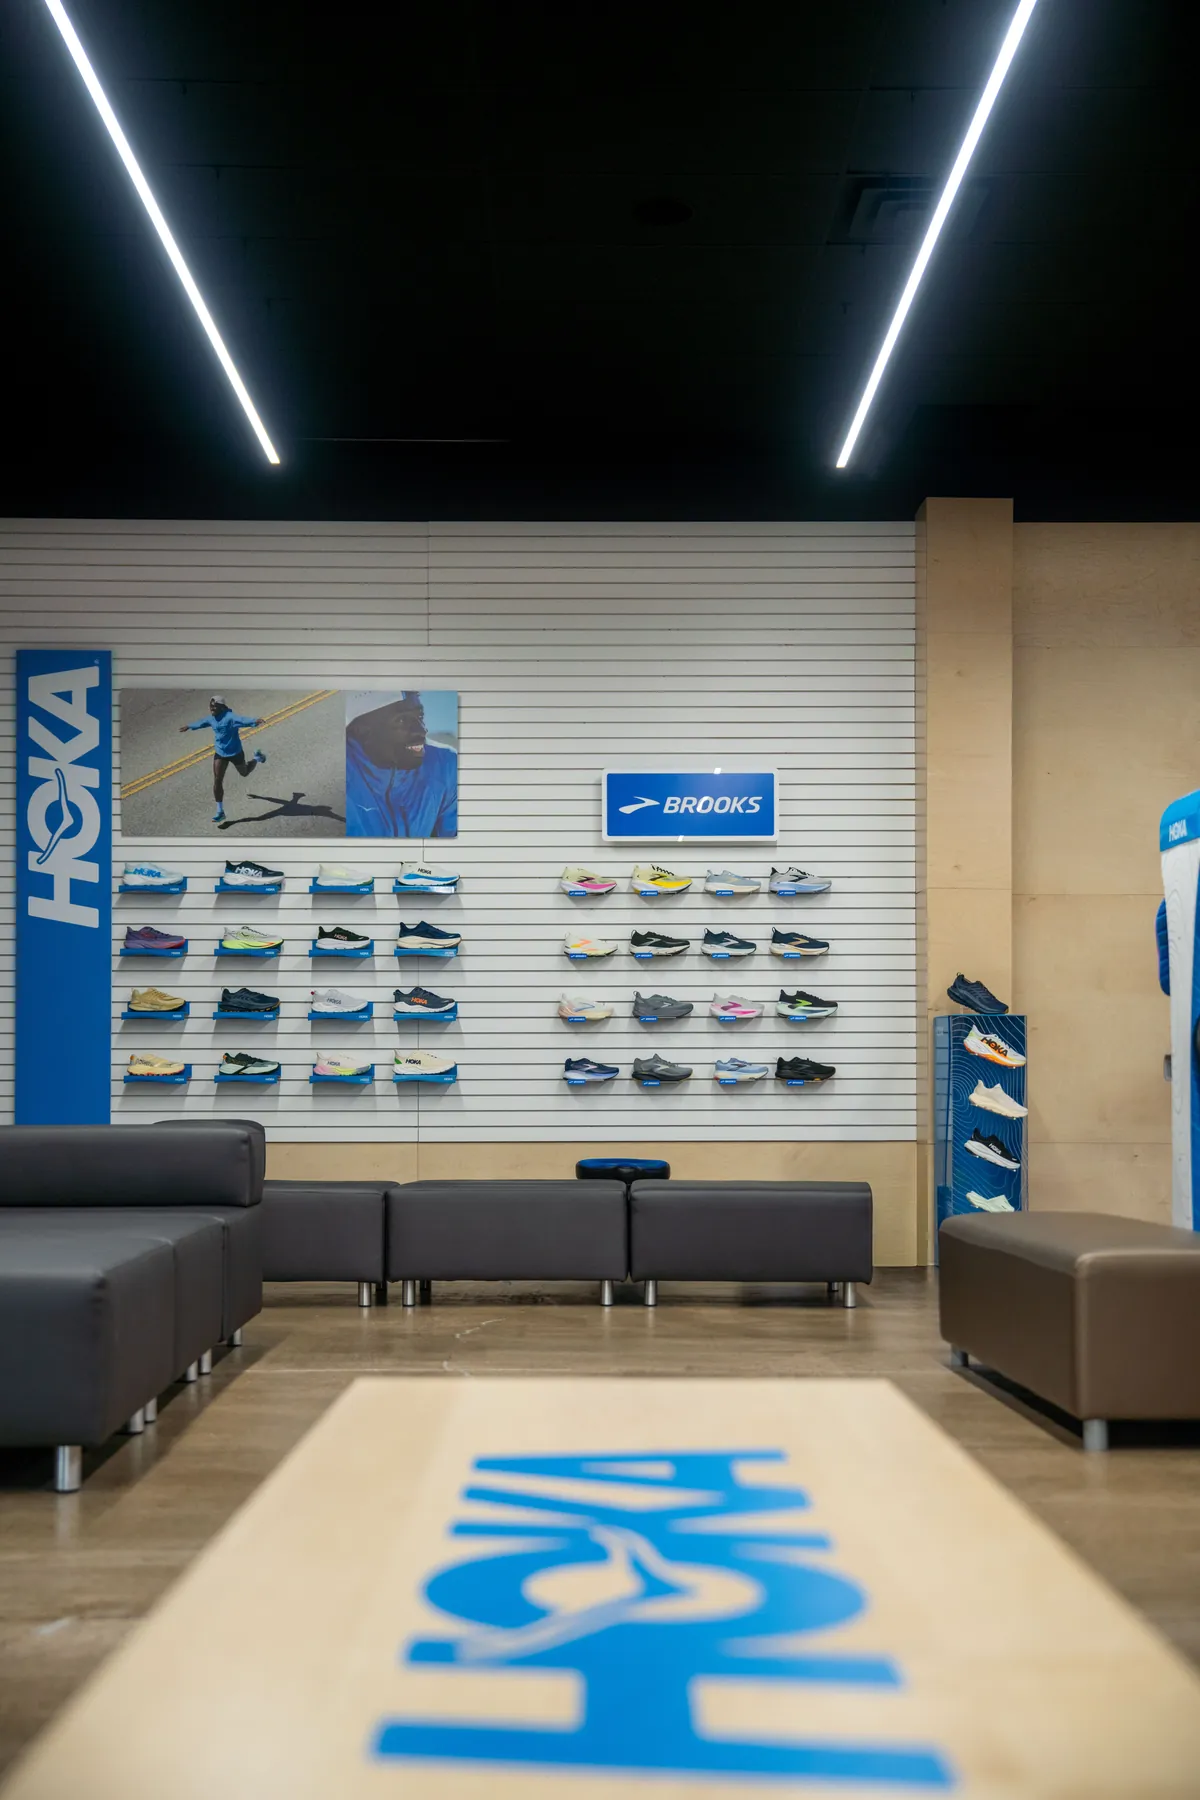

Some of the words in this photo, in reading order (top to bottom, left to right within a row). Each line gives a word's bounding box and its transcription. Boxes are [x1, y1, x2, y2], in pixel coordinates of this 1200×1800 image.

[27, 666, 100, 928] HOKA
[663, 796, 763, 814] BROOKS
[1169, 819, 1187, 842] HOKA
[133, 867, 162, 878] HOKA
[234, 866, 263, 878] HOKA
[417, 867, 432, 875] HOKA
[411, 997, 428, 1005] HOKA
[980, 1036, 1008, 1057] HOKA
[988, 1142, 1002, 1155] HOKA
[371, 1450, 957, 1791] HOKA
